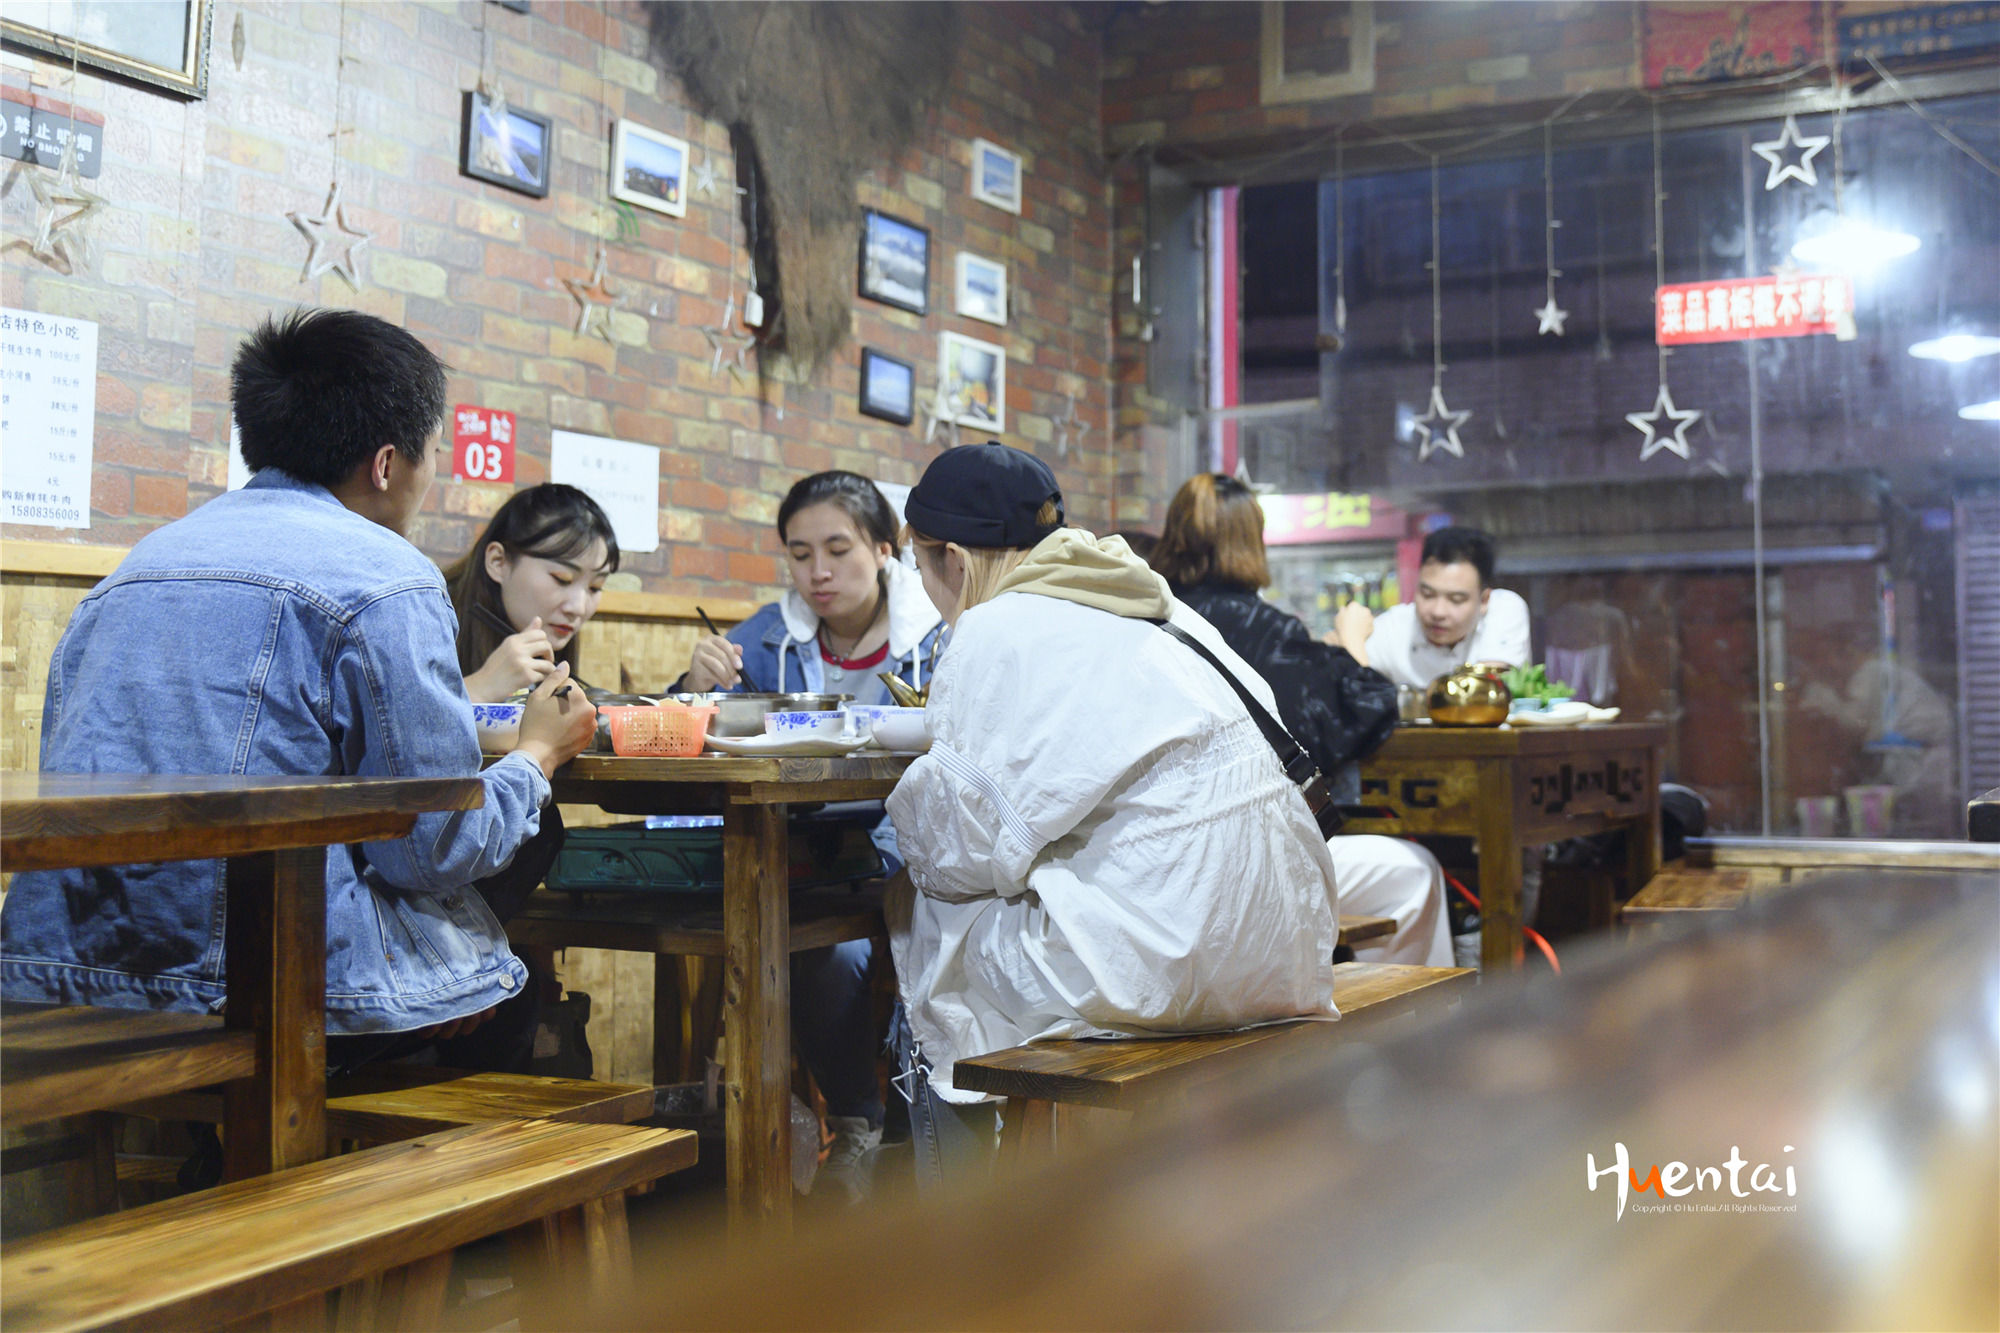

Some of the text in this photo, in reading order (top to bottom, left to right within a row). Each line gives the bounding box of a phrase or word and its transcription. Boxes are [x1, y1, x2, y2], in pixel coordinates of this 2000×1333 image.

[14, 115, 93, 153] 禁止吸烟
[19, 136, 36, 149] NO
[464, 441, 503, 480] 03
[11, 504, 80, 521] 15808356009
